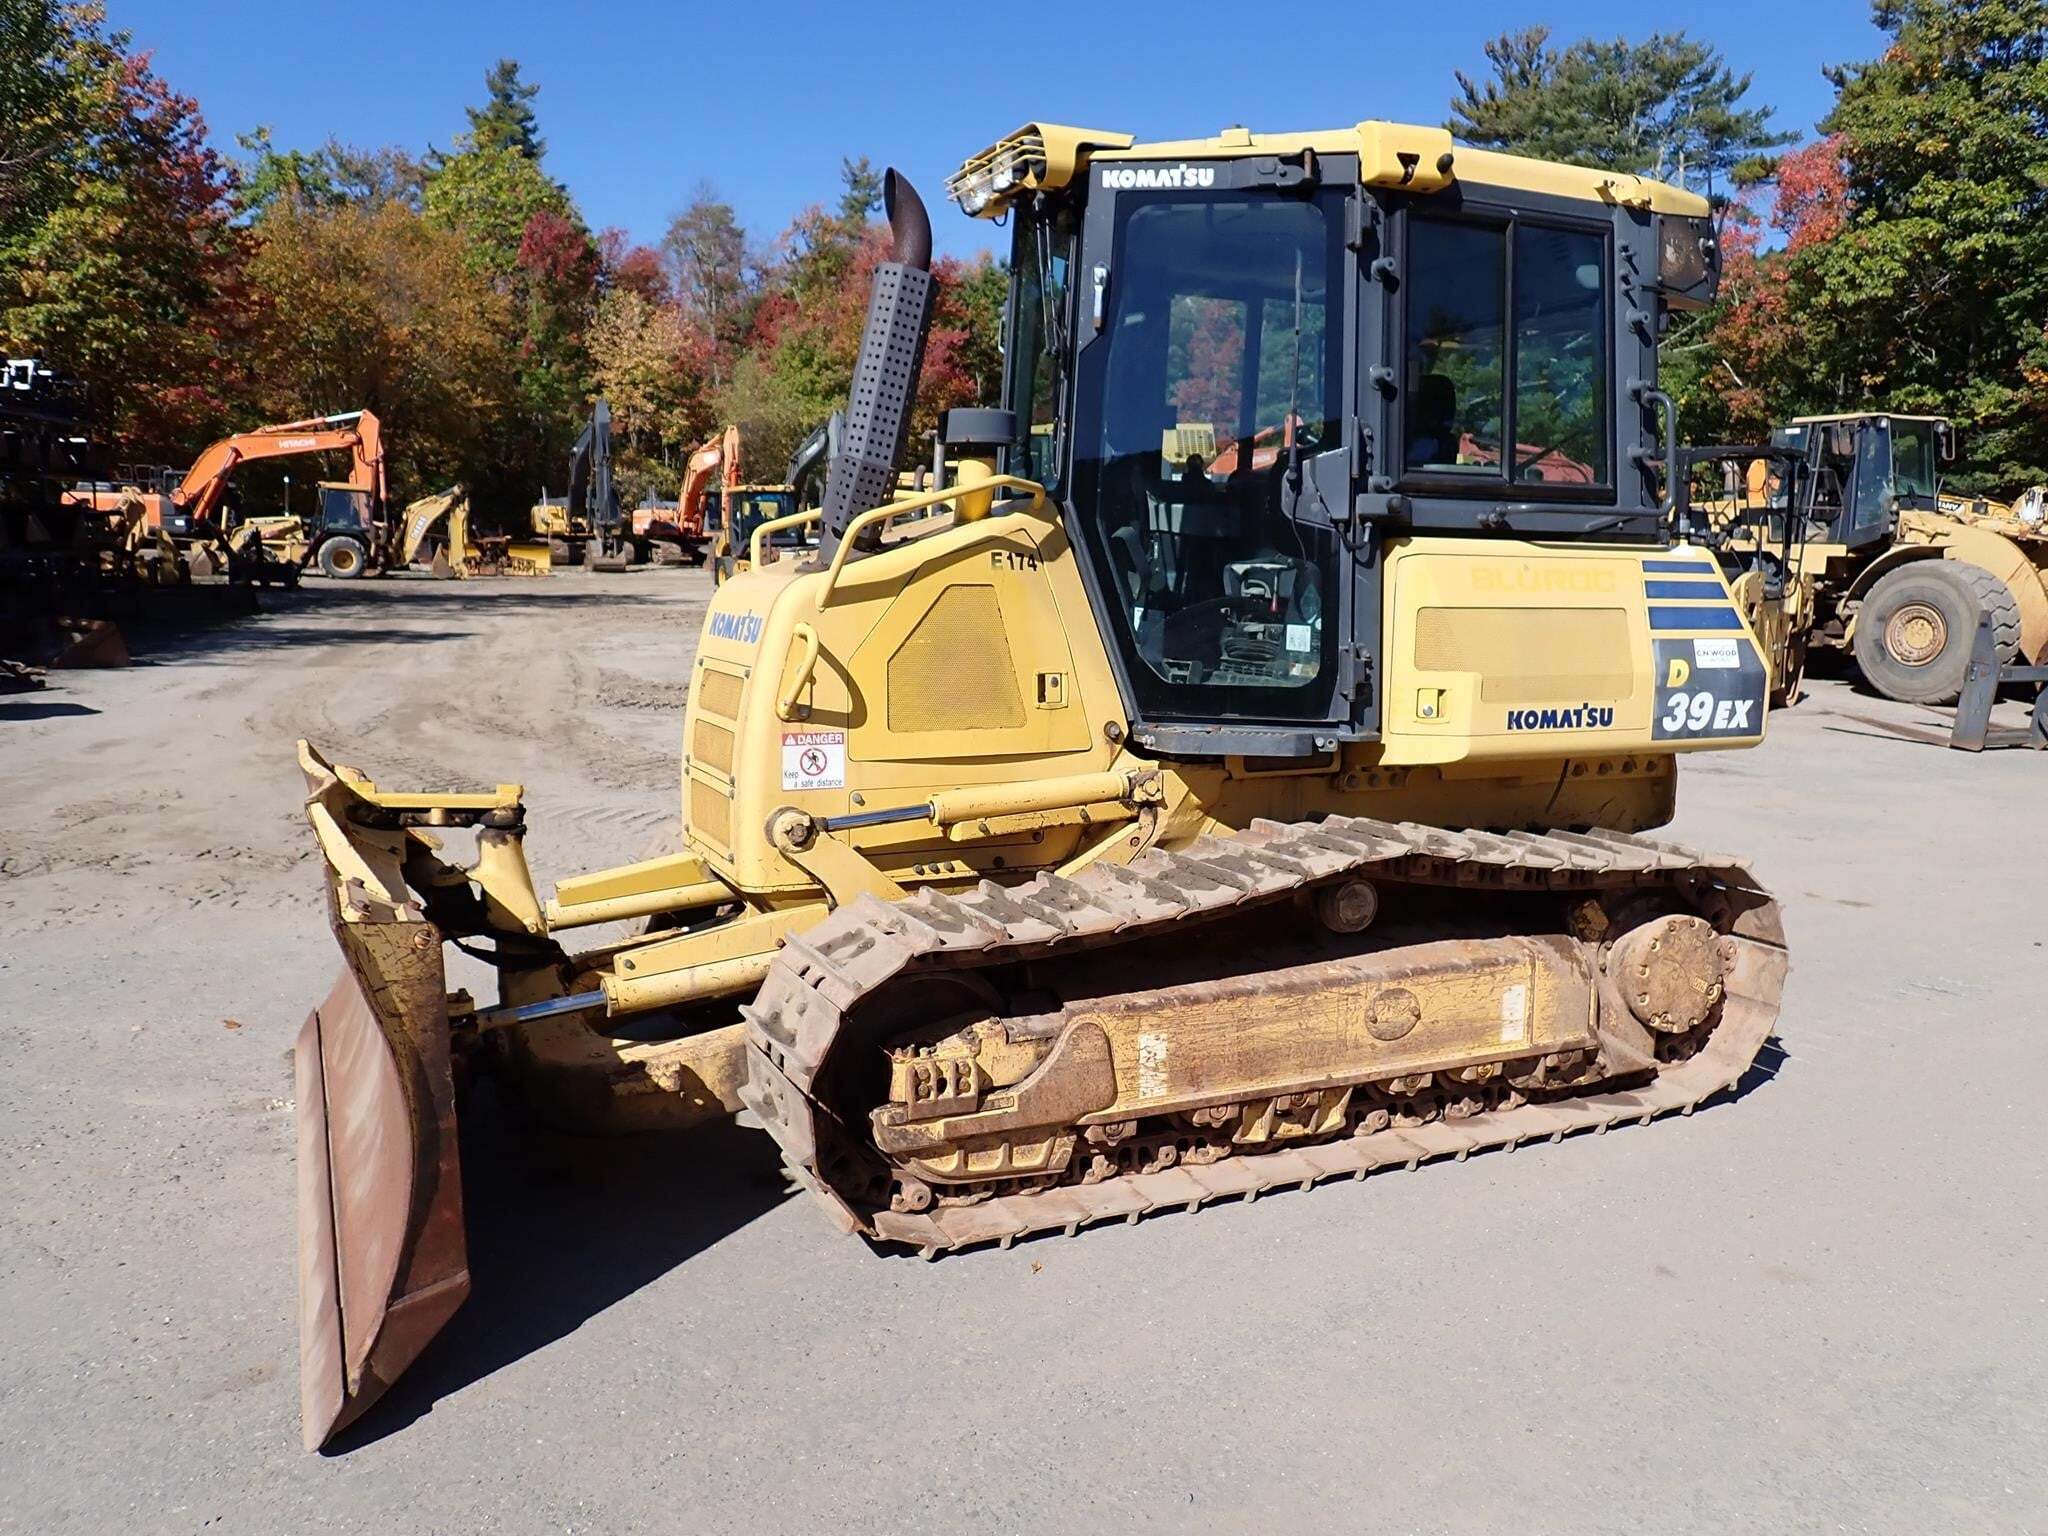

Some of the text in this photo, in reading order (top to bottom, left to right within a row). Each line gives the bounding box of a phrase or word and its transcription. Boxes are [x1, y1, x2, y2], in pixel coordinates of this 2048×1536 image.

[1102, 163, 1214, 188] KOMATSU
[709, 609, 763, 644] KOMATSU
[1666, 658, 1690, 688] D
[1507, 702, 1613, 730] KOMATSU
[797, 733, 843, 745] DANGER
[784, 769, 799, 779] Keep
[801, 778, 814, 788] safe
[816, 778, 842, 787] distance
